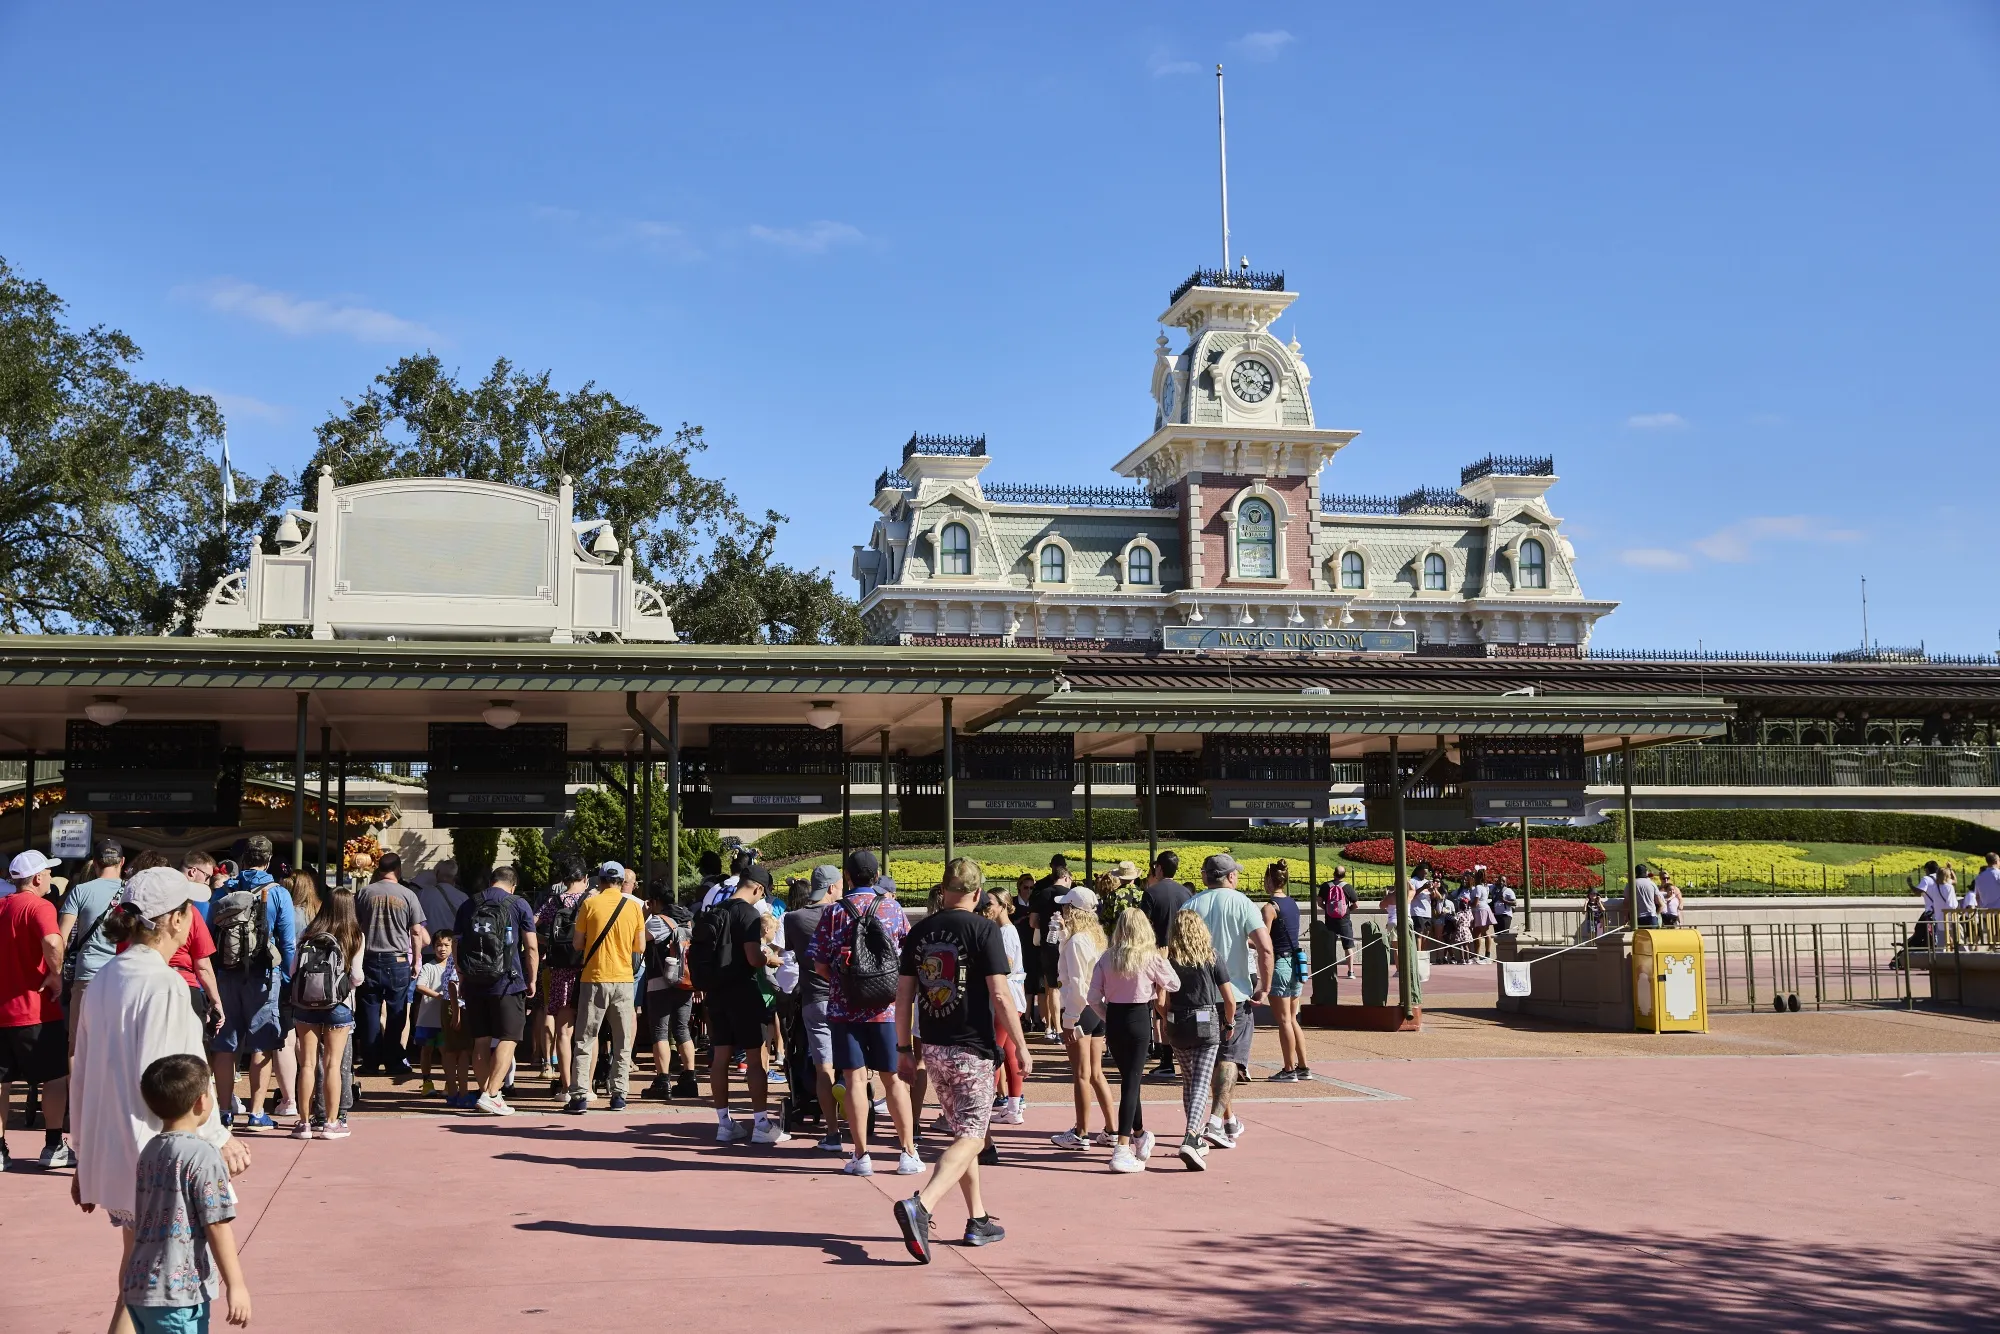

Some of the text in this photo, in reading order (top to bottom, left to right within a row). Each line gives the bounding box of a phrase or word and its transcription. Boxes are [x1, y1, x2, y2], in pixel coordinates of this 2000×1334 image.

[1219, 631, 1364, 649] MAGIC KINGDOM
[109, 792, 172, 801] GUEST ENTRANCE
[468, 794, 526, 803] GUEST ENTRANCE
[752, 795, 802, 804] GUEST ENTRANCE
[985, 800, 1037, 808] GUEST ENTRANCE
[1245, 800, 1295, 808] GUEST ENTRANCE
[1329, 803, 1362, 815] RLD'S
